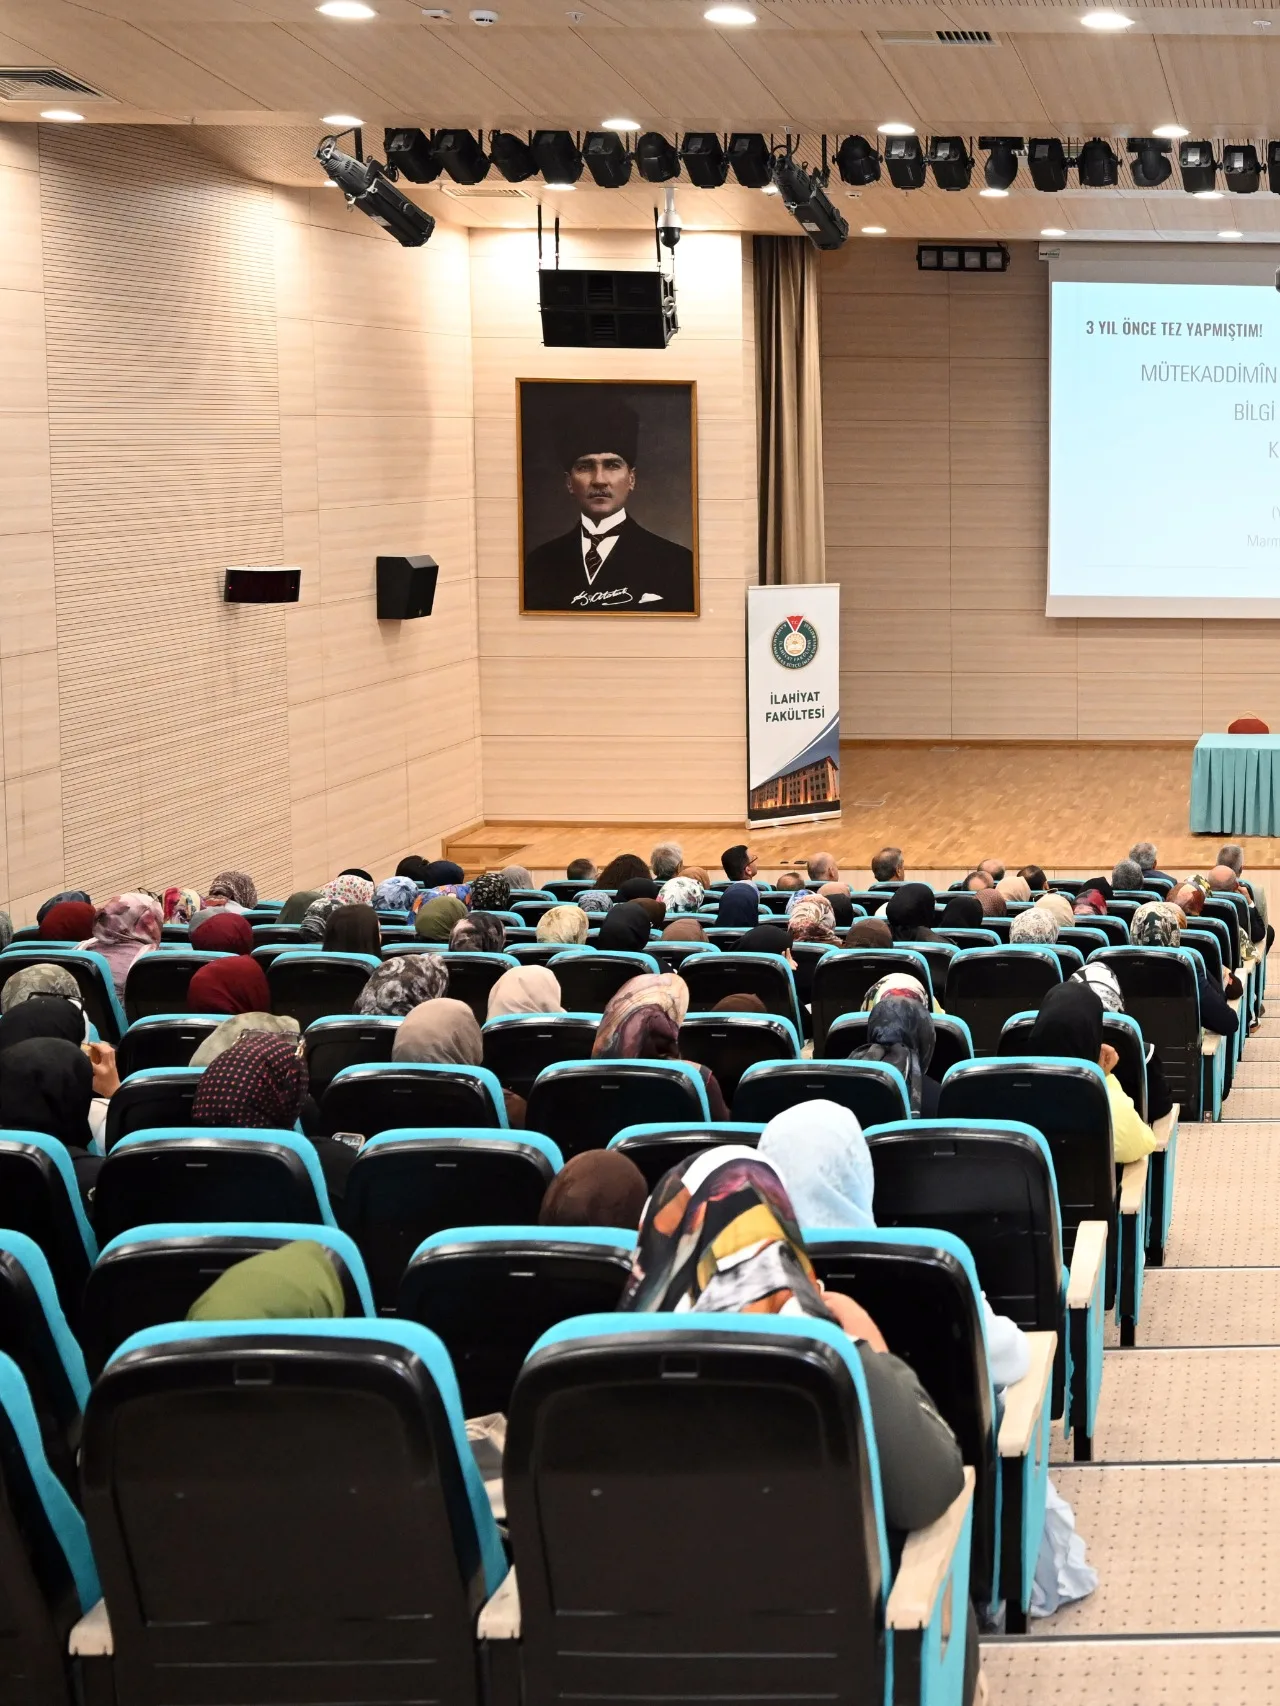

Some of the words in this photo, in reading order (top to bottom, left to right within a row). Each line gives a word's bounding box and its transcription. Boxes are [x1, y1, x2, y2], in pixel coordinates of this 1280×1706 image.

[1086, 320, 1095, 335] 3
[1099, 321, 1118, 335] YIL
[1122, 317, 1157, 336] ÖNCE
[1161, 322, 1182, 336] TEZ
[1186, 322, 1263, 341] YAPMIŞTIM!
[1141, 361, 1277, 384] MÜTEKADDİMÎN
[1234, 400, 1276, 421] BİLGİ
[770, 690, 820, 705] İLAHİYAT
[765, 705, 825, 723] FAKÜLTESİ
